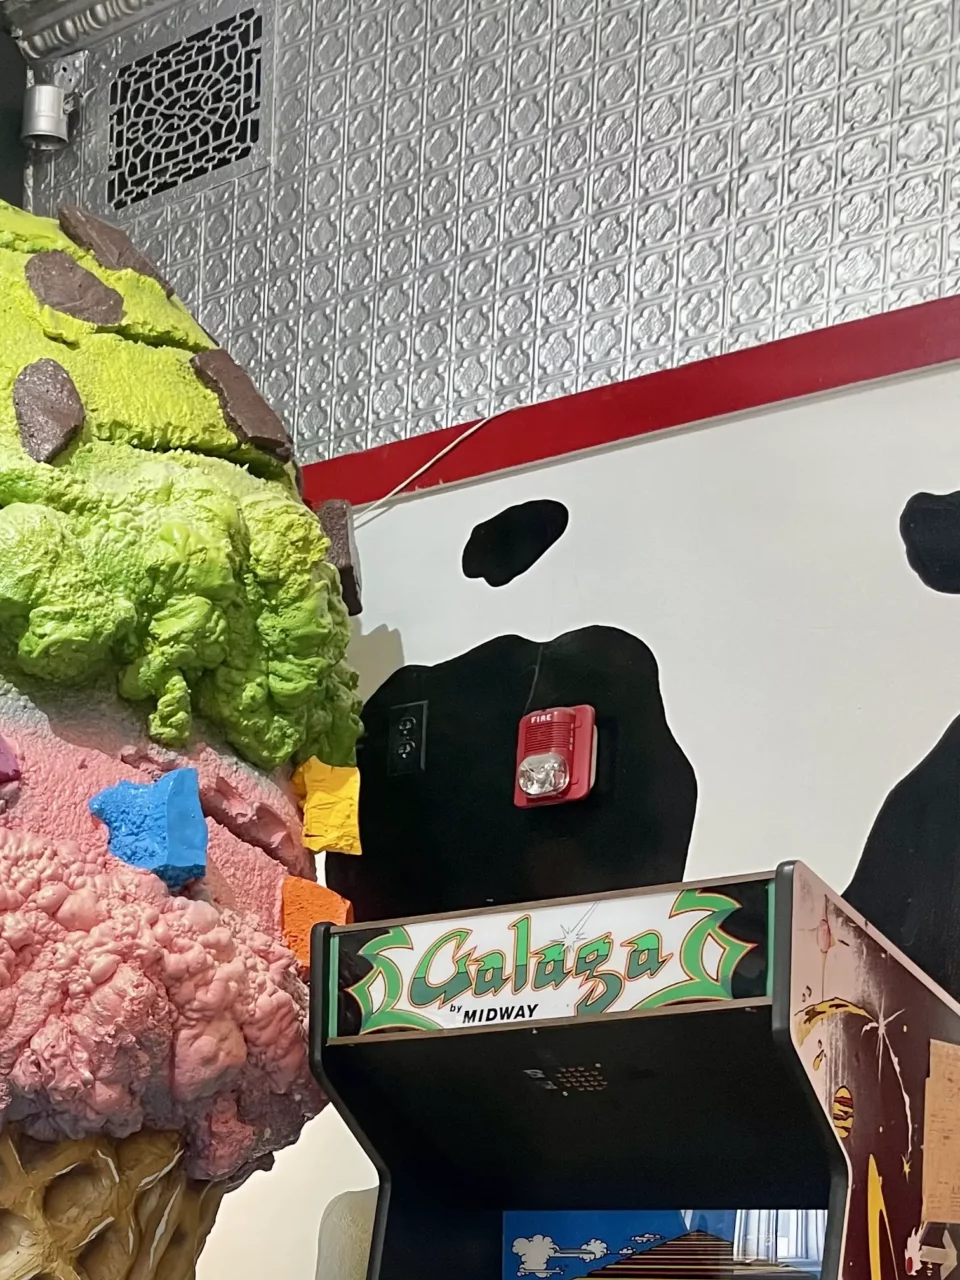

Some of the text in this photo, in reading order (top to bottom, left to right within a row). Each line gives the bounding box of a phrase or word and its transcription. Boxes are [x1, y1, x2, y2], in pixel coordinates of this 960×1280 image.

[531, 714, 552, 724] FIRE
[409, 913, 674, 1017] Galaga
[449, 1003, 539, 1023] by MIDWAY
